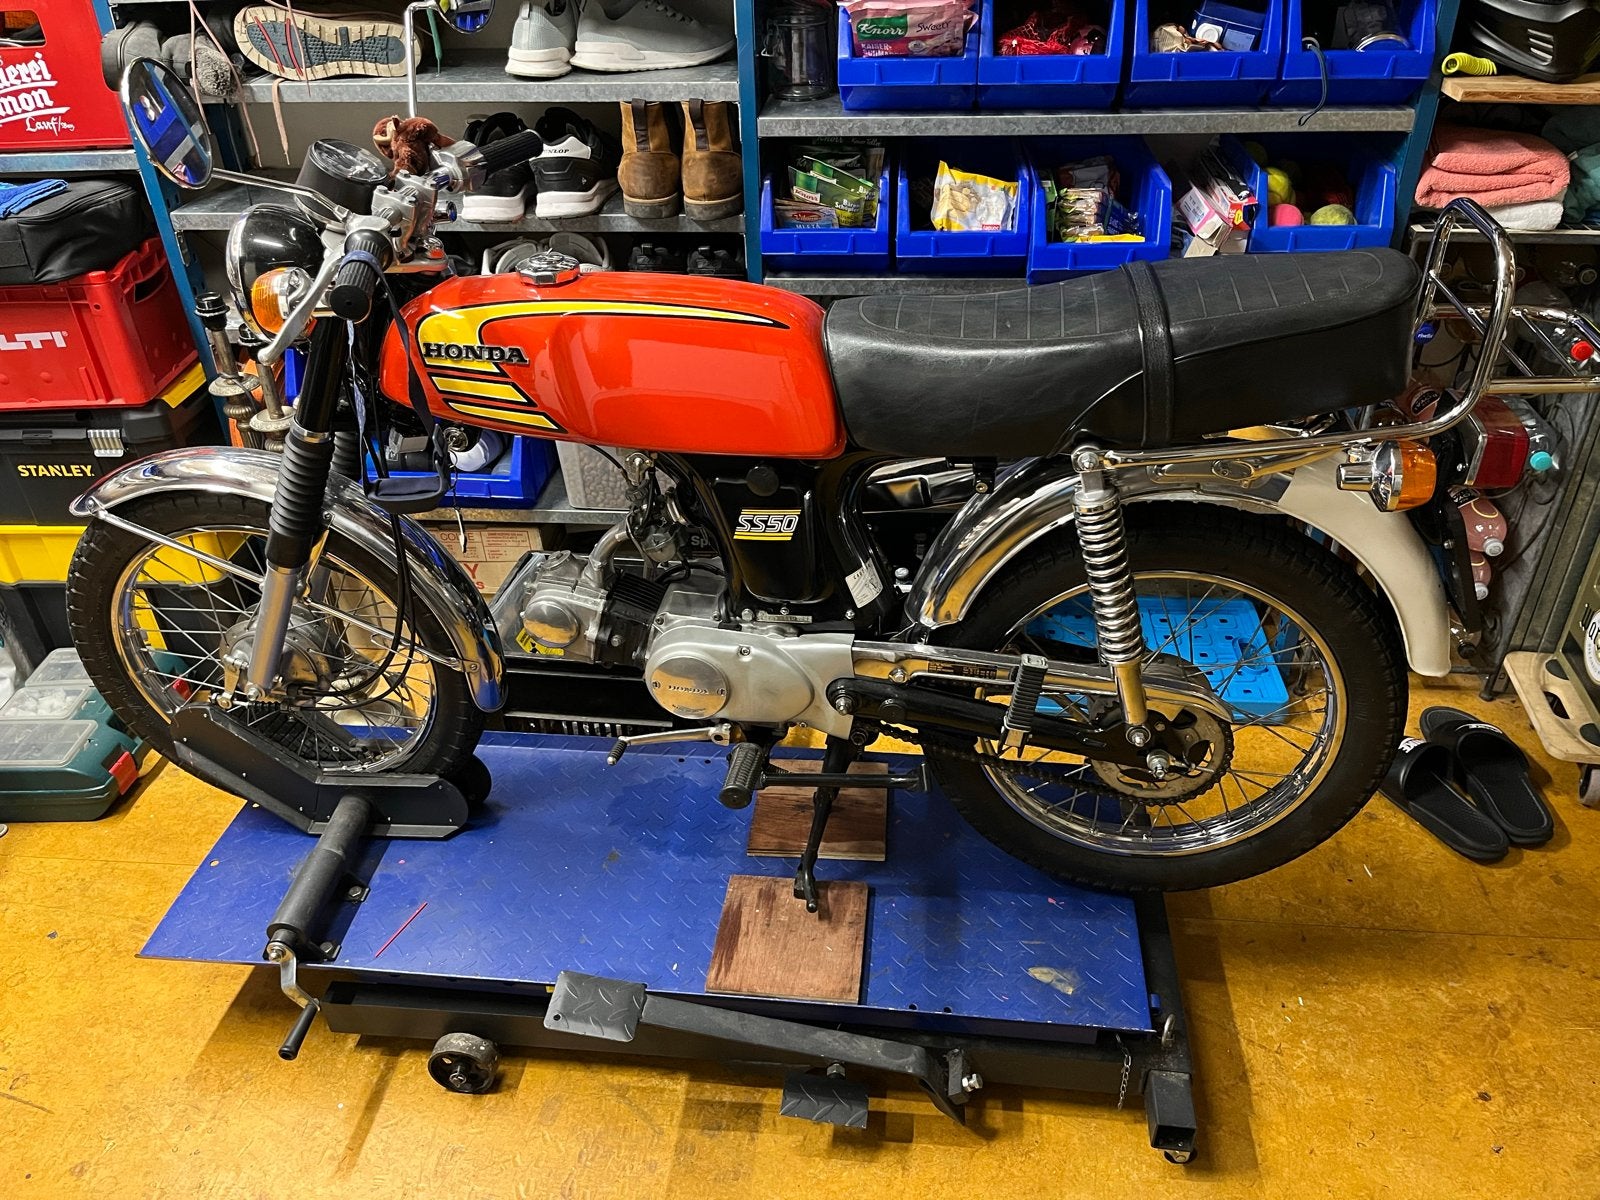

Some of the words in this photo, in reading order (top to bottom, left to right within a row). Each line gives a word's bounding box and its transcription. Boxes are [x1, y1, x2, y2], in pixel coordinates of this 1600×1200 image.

[857, 23, 906, 36] Knorr
[423, 342, 529, 364] HONDA
[735, 514, 799, 533] SS50
[690, 535, 711, 549] Sp
